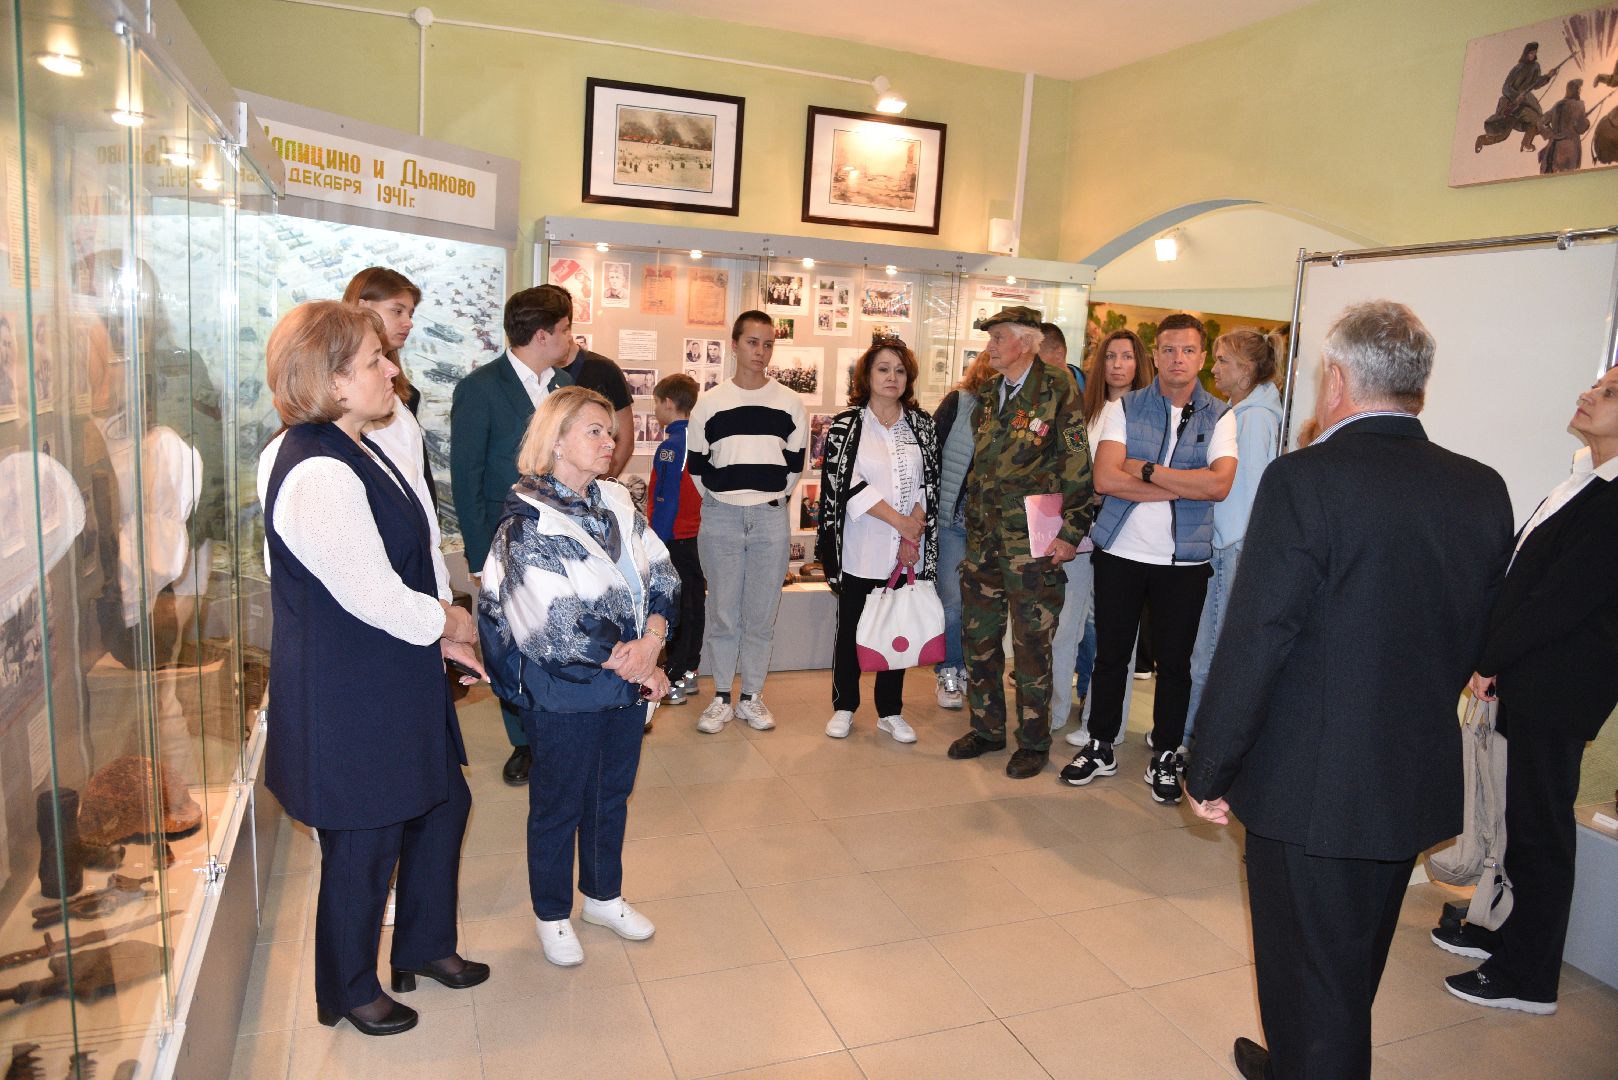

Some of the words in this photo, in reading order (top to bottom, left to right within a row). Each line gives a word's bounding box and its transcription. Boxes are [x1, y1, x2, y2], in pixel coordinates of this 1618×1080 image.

[264, 126, 361, 175] алицино
[373, 159, 385, 179] и
[400, 159, 476, 199] Дьяково
[288, 167, 362, 195] ДЕКАБРЯ
